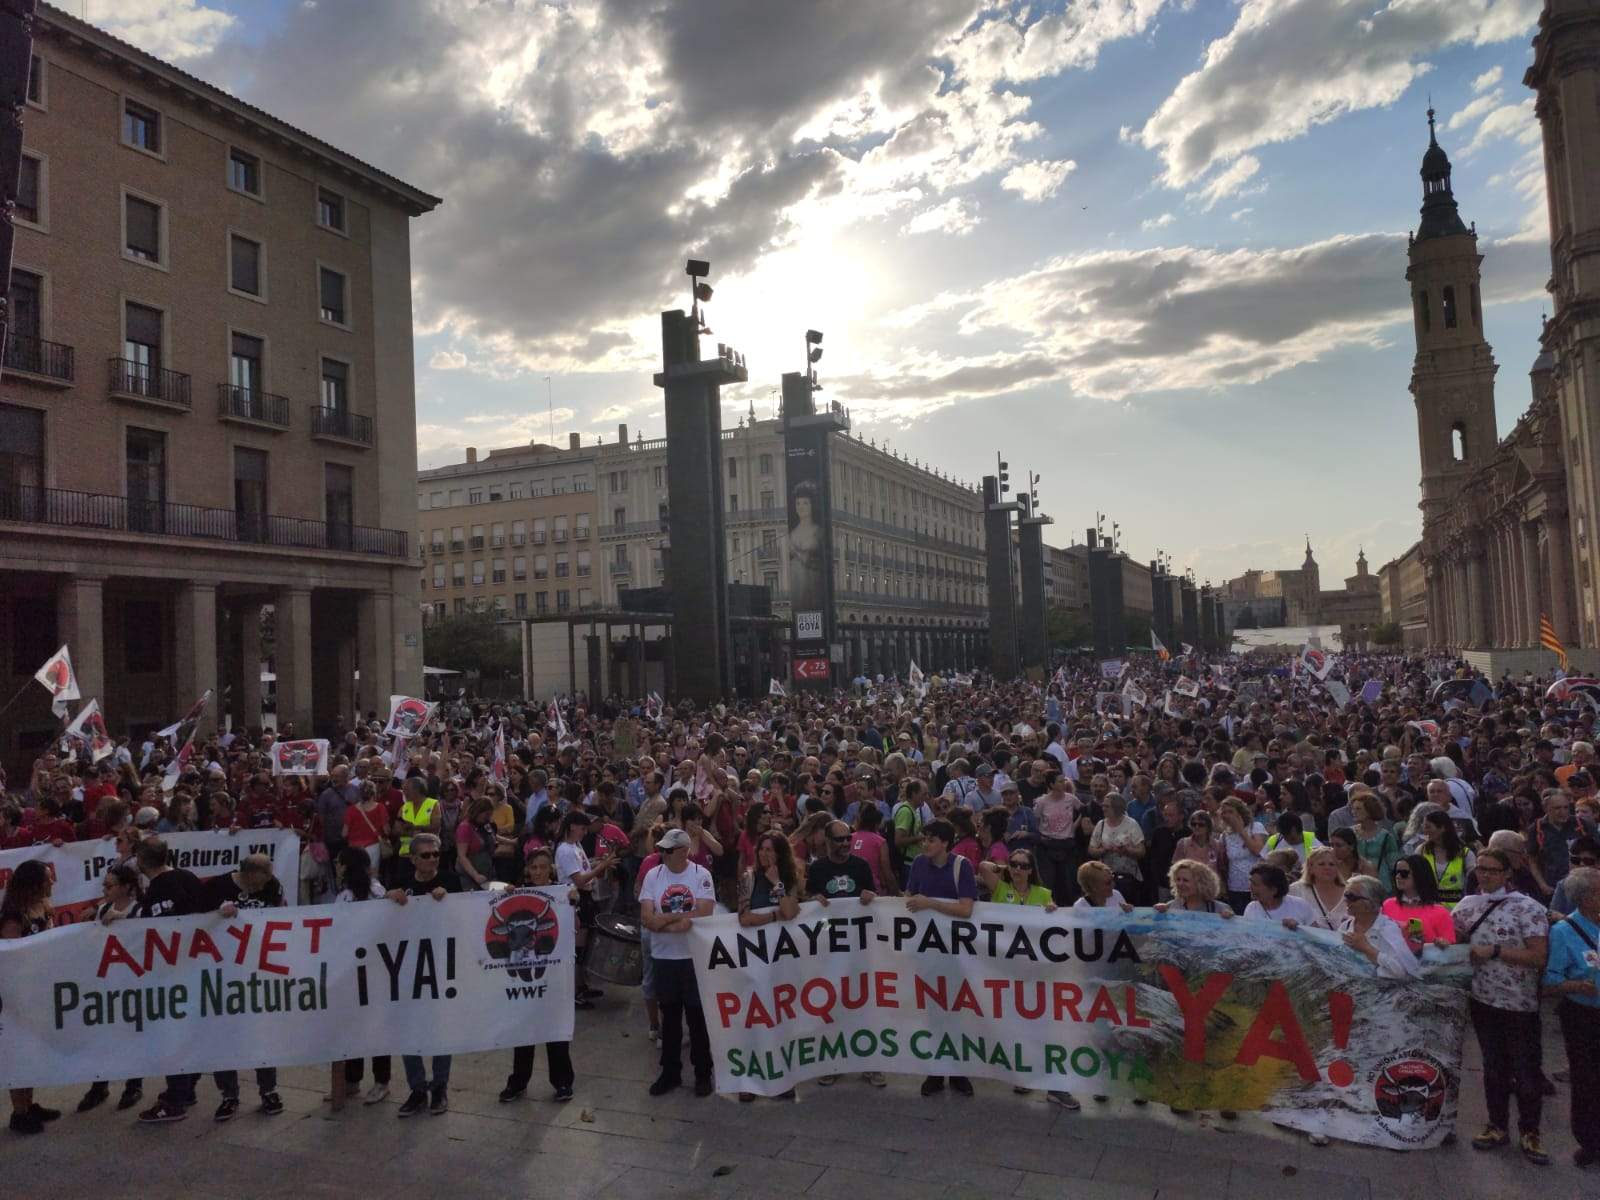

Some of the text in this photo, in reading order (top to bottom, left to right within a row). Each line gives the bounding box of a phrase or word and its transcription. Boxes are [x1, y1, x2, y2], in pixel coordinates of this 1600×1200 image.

[799, 623, 820, 631] GOYA
[97, 917, 333, 978] ANAYET
[708, 915, 1142, 970] ANAYET-PARTACUA
[54, 936, 457, 1032] Parque Natural ¡YA!
[505, 984, 548, 1001] WWF
[716, 971, 1151, 1029] PARQUE NATURAL
[1158, 964, 1355, 1088] YA!
[727, 1028, 1155, 1086] SALVEMOS CANAL ROYA
